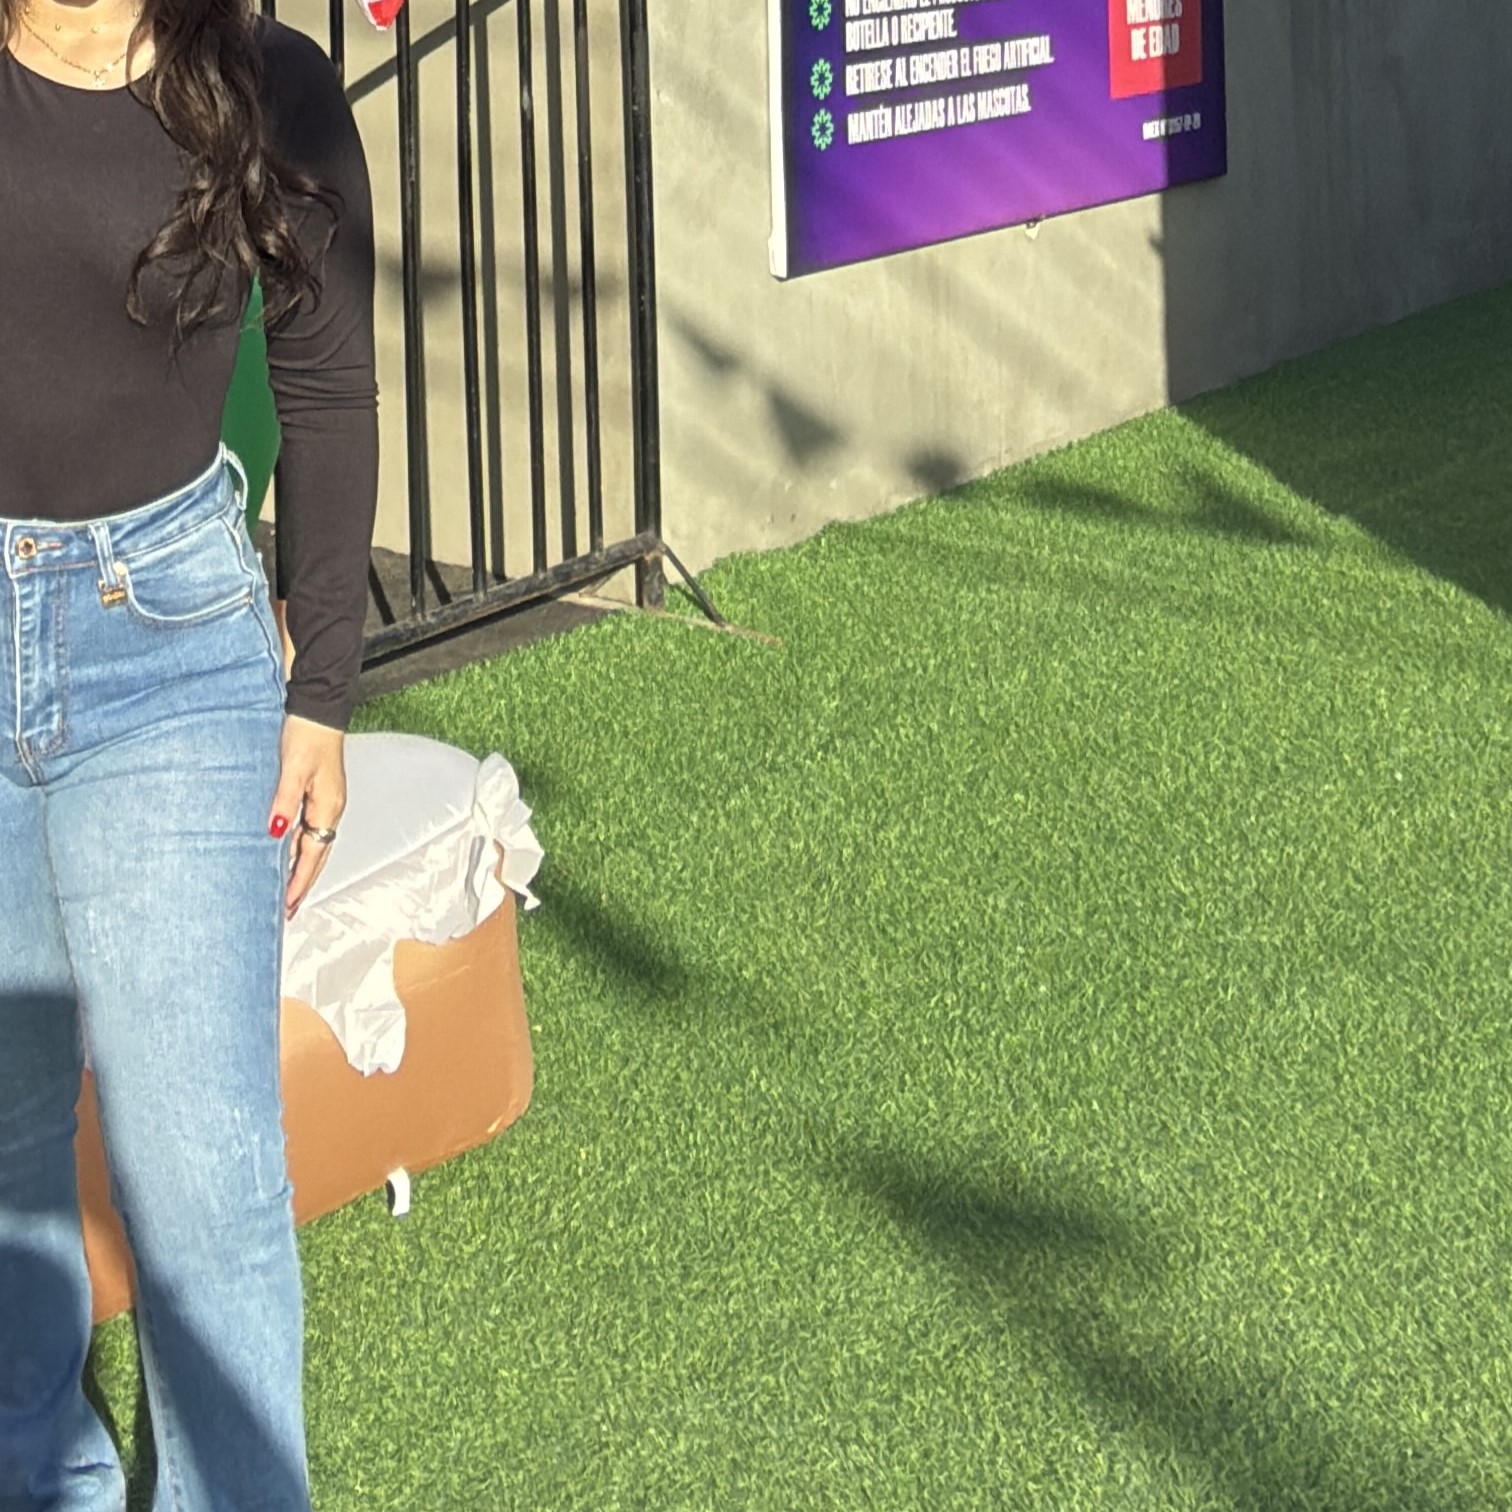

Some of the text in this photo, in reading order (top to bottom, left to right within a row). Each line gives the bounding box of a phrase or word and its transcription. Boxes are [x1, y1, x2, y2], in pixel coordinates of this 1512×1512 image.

[846, 17, 889, 53] BOTELLA
[891, 16, 899, 45] O
[1131, 24, 1180, 61] DE EDAD
[895, 57, 908, 88] AL
[910, 49, 959, 86] ENCENDER
[960, 47, 972, 77] EL
[973, 42, 1001, 76] FUEGO
[848, 104, 892, 145] MANTÉN
[894, 97, 945, 136] ALEJADAS
[947, 96, 955, 127] A
[957, 92, 975, 124] LAS
